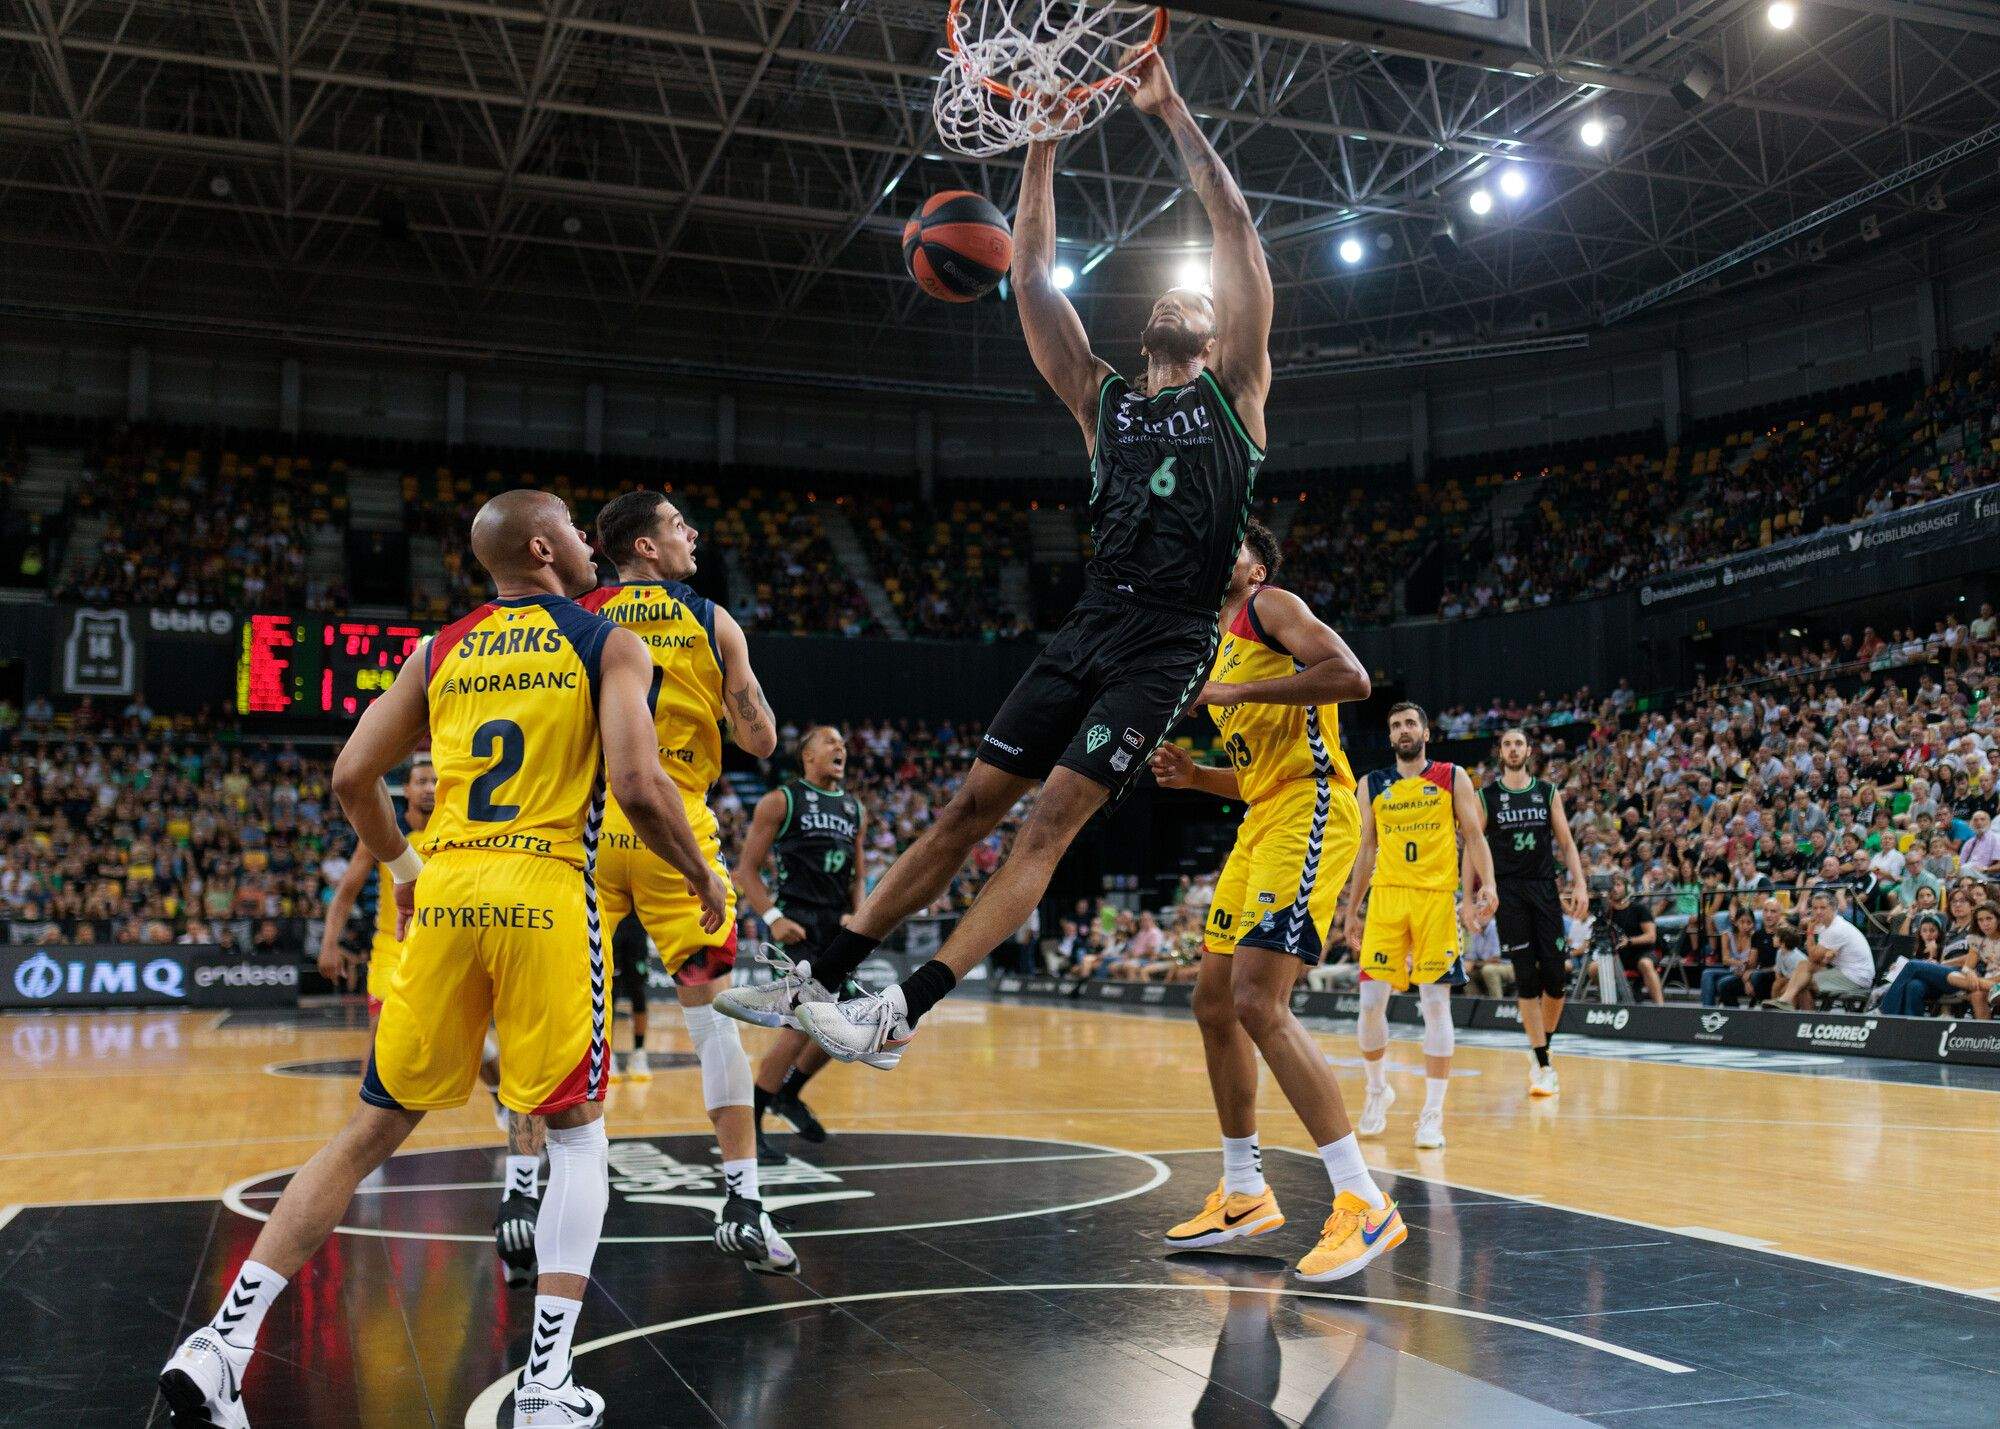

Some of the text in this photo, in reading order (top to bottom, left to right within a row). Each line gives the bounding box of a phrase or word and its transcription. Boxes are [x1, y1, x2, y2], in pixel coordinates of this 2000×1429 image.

[1150, 456, 1176, 497] 6
[1863, 512, 1960, 549] @CDBILBAOBASKET
[458, 626, 563, 659] STARKS
[640, 634, 696, 649] ABANC
[458, 672, 577, 695] MORABANC
[989, 737, 1019, 756] CORREO
[467, 718, 525, 823] 2
[1496, 808, 1547, 824] surne
[1405, 841, 1418, 863] 0
[1512, 831, 1537, 851] 34
[824, 849, 847, 873] 19
[66, 958, 186, 997] IMQ
[194, 962, 298, 987] endesa
[1797, 1023, 1870, 1042] EL CORREO
